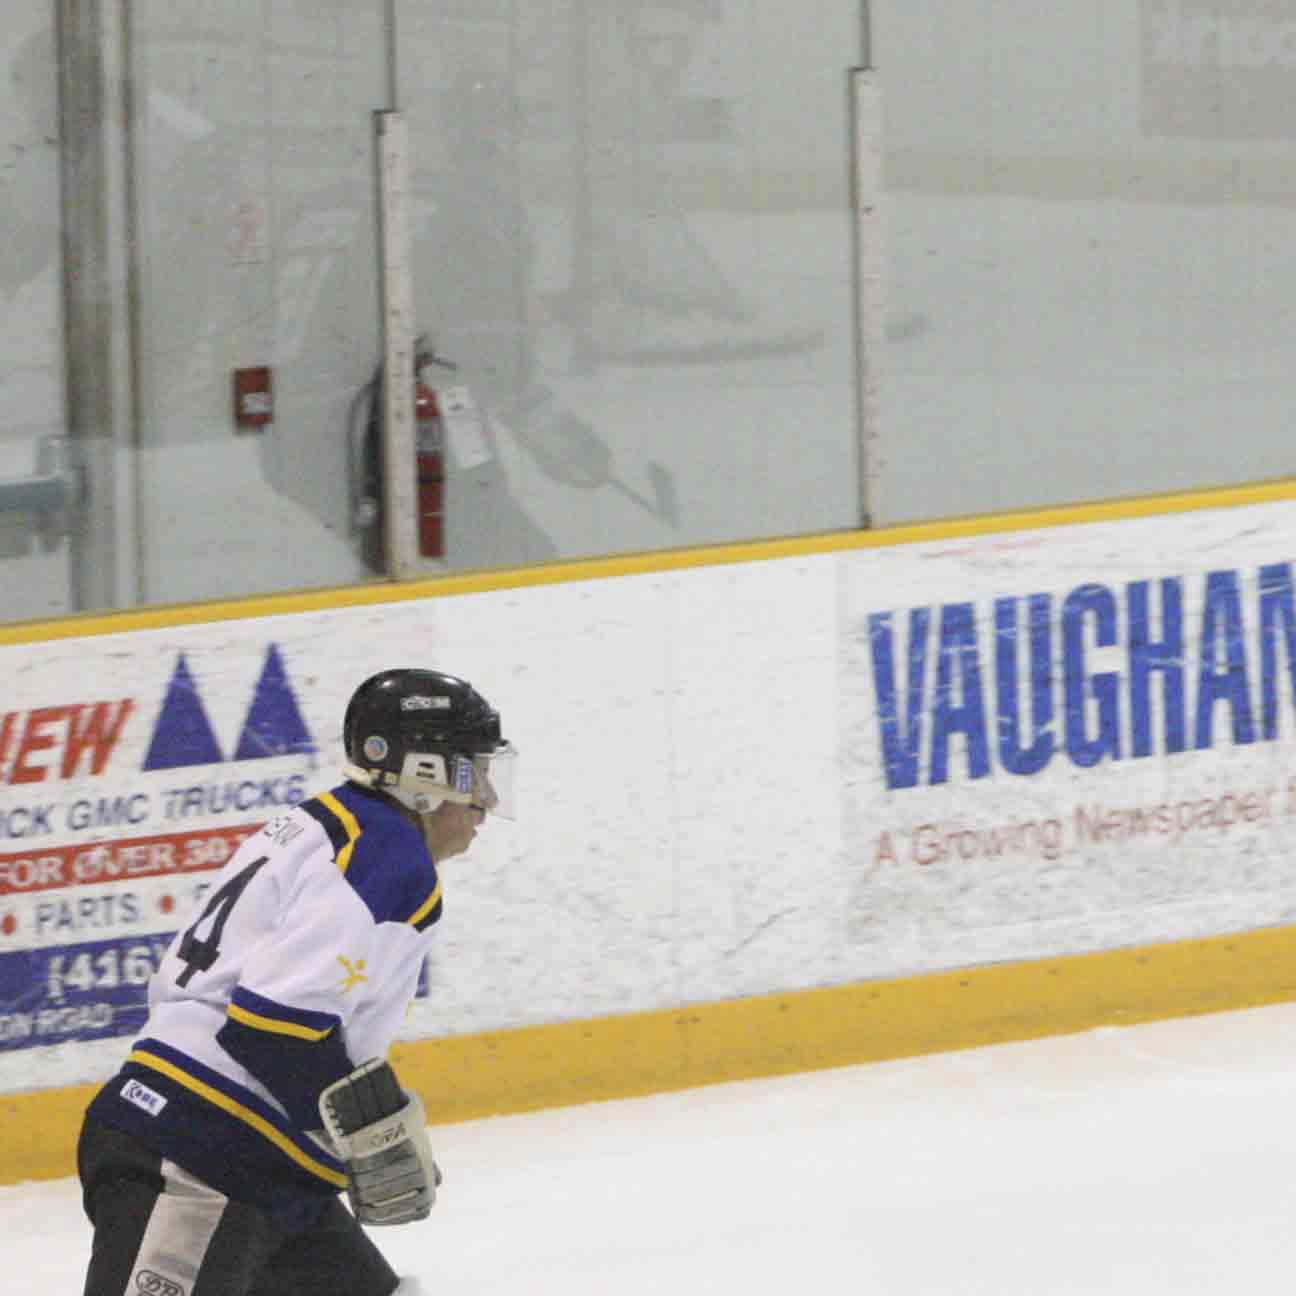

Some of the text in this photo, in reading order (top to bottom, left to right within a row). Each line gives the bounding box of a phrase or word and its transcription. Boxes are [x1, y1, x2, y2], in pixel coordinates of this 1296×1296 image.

[65, 787, 148, 832] GMC
[161, 773, 306, 820] TRUCKS
[872, 829, 898, 868] A
[911, 817, 1063, 866] Growing
[1075, 785, 1272, 845] Newspaper
[72, 838, 177, 882] OVER
[33, 891, 141, 936] PARTS
[175, 855, 270, 989] 4
